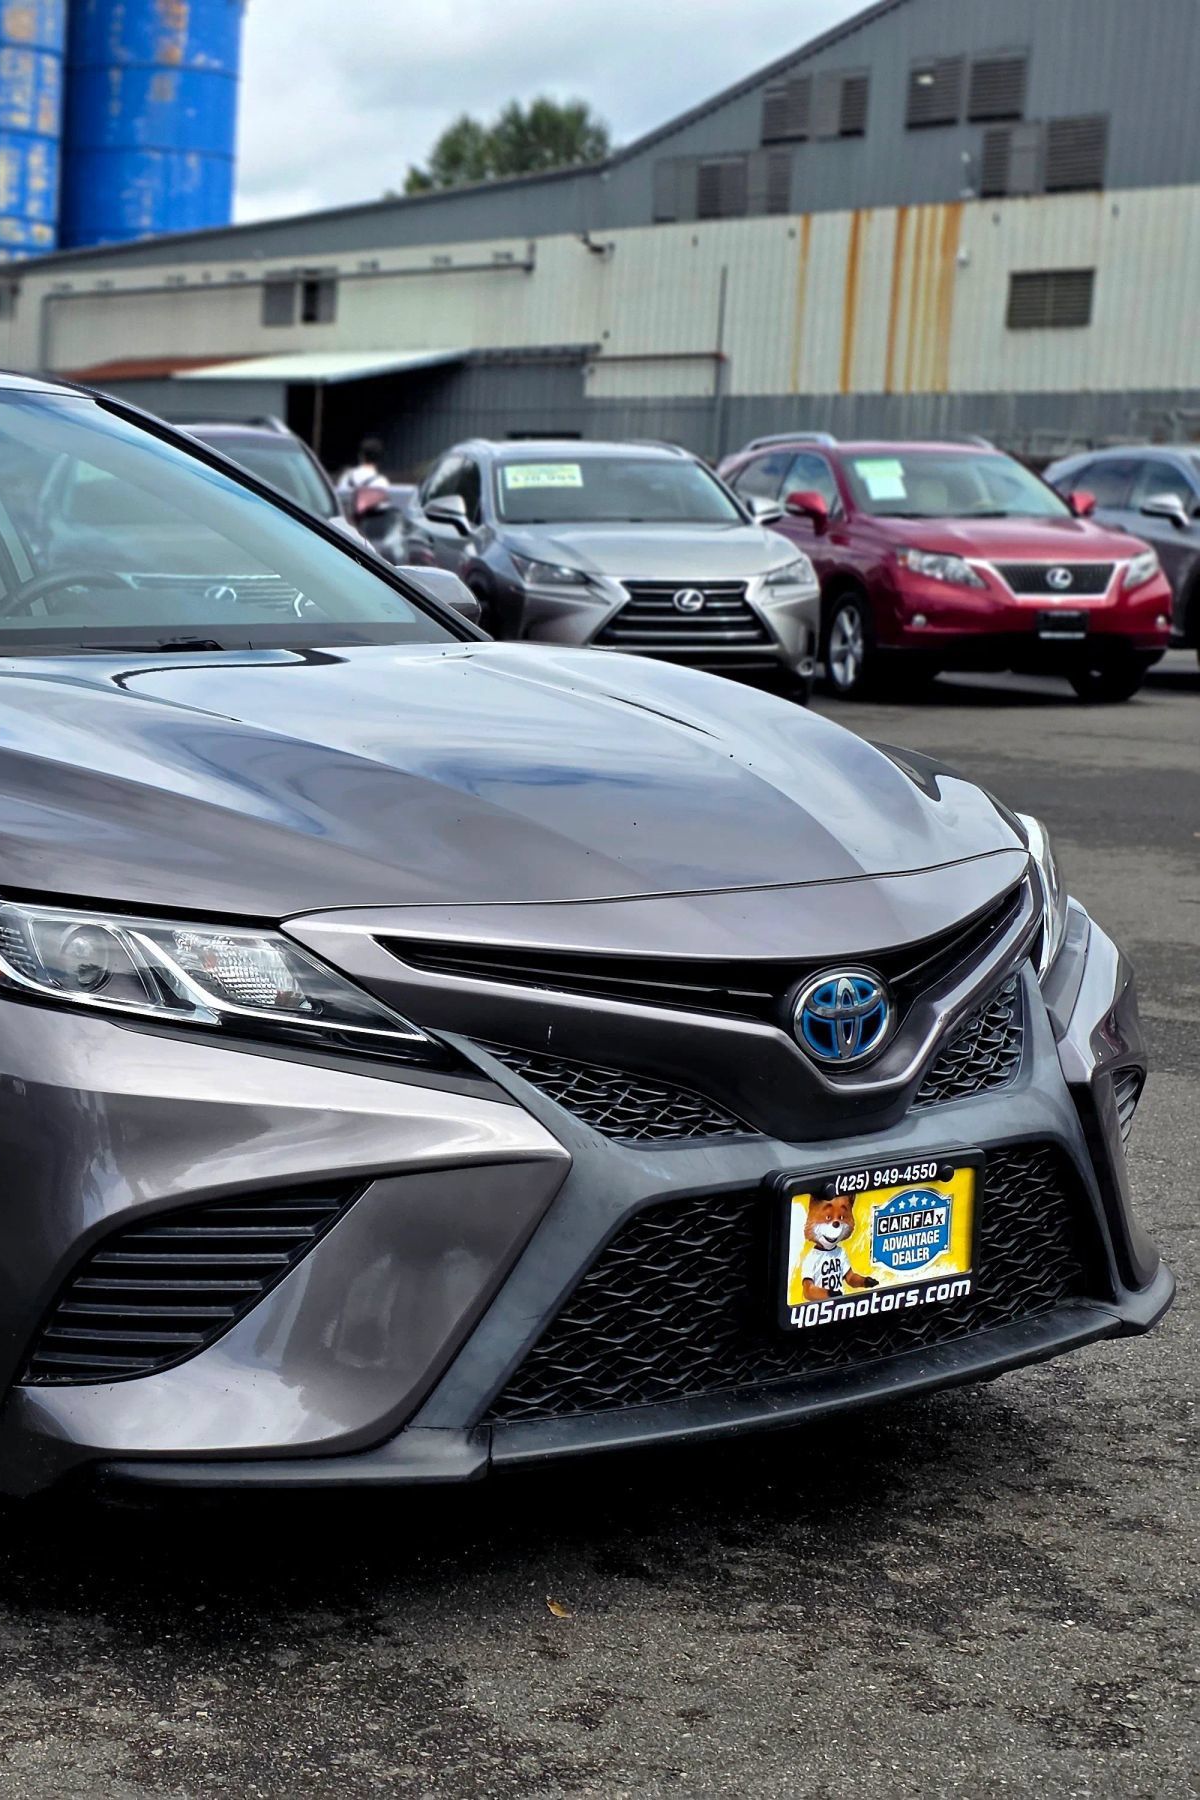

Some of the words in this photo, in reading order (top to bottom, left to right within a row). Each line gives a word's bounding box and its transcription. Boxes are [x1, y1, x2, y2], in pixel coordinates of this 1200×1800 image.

[835, 1172, 869, 1194] (425)
[873, 1163, 937, 1186] 949-4550
[878, 1211, 946, 1234] CARFAX
[882, 1230, 939, 1252] ADVANTAGE
[821, 1258, 842, 1277] CAR
[892, 1248, 929, 1266] DEALER
[821, 1275, 843, 1290] FOX
[791, 1280, 970, 1328] 405motors.com
